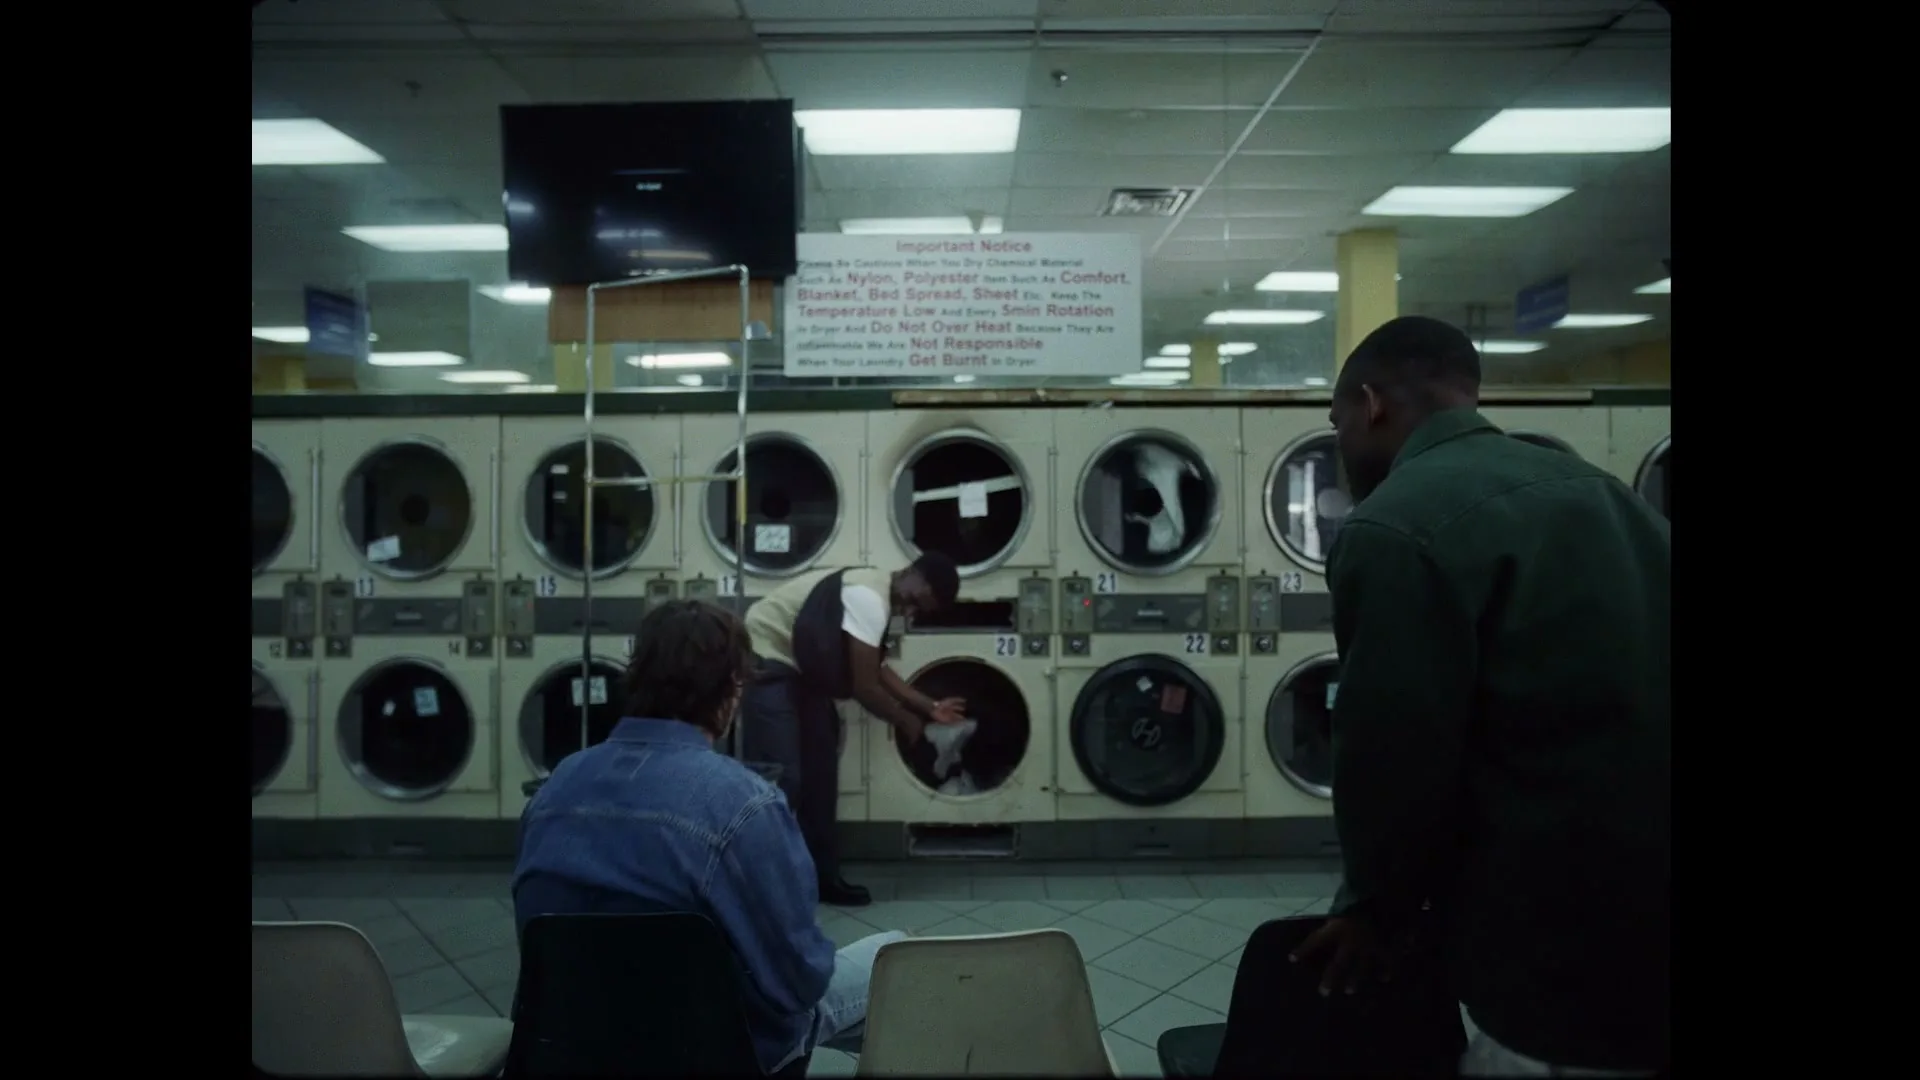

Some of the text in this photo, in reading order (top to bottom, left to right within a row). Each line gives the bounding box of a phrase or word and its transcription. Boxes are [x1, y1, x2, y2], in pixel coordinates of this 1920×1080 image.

[897, 240, 1032, 254] Important Notice
[905, 259, 936, 268] When
[940, 259, 961, 268] You
[963, 259, 983, 269] Dry
[986, 259, 1036, 267] Chemical
[1040, 258, 1083, 267] Material
[797, 276, 825, 285] Such
[828, 276, 842, 284] As
[847, 272, 897, 287] Nylon,
[903, 272, 978, 286] Polyester
[1010, 275, 1037, 284] Such
[1041, 275, 1055, 284] As
[1060, 270, 1131, 285] Comfort,
[797, 288, 863, 302] Blanket,
[868, 288, 898, 301] Bed
[905, 288, 966, 303] Spread,
[973, 287, 1018, 300] Sheet
[1050, 291, 1079, 301] Keep
[1082, 291, 1102, 300] The
[798, 304, 1114, 319] Temperature Low And Every 5min Rotation
[811, 324, 841, 335] Dryer
[845, 324, 866, 333] And
[871, 321, 893, 333] Do
[898, 321, 926, 334] Not
[932, 320, 969, 333] Over
[975, 320, 1012, 333] Heat
[1016, 324, 1062, 333] Because
[1067, 324, 1092, 335] They
[1095, 324, 1114, 333] Are
[887, 341, 906, 350] Are
[910, 337, 937, 350] Not
[944, 337, 1044, 351] Responsible
[860, 357, 905, 368] Laundry
[908, 353, 937, 367] Get
[942, 353, 987, 367] Burnt
[540, 576, 557, 596] 15
[1099, 574, 1116, 592] 21
[1284, 574, 1302, 592] 23
[997, 637, 1017, 656] 20
[1186, 635, 1205, 653] 22
